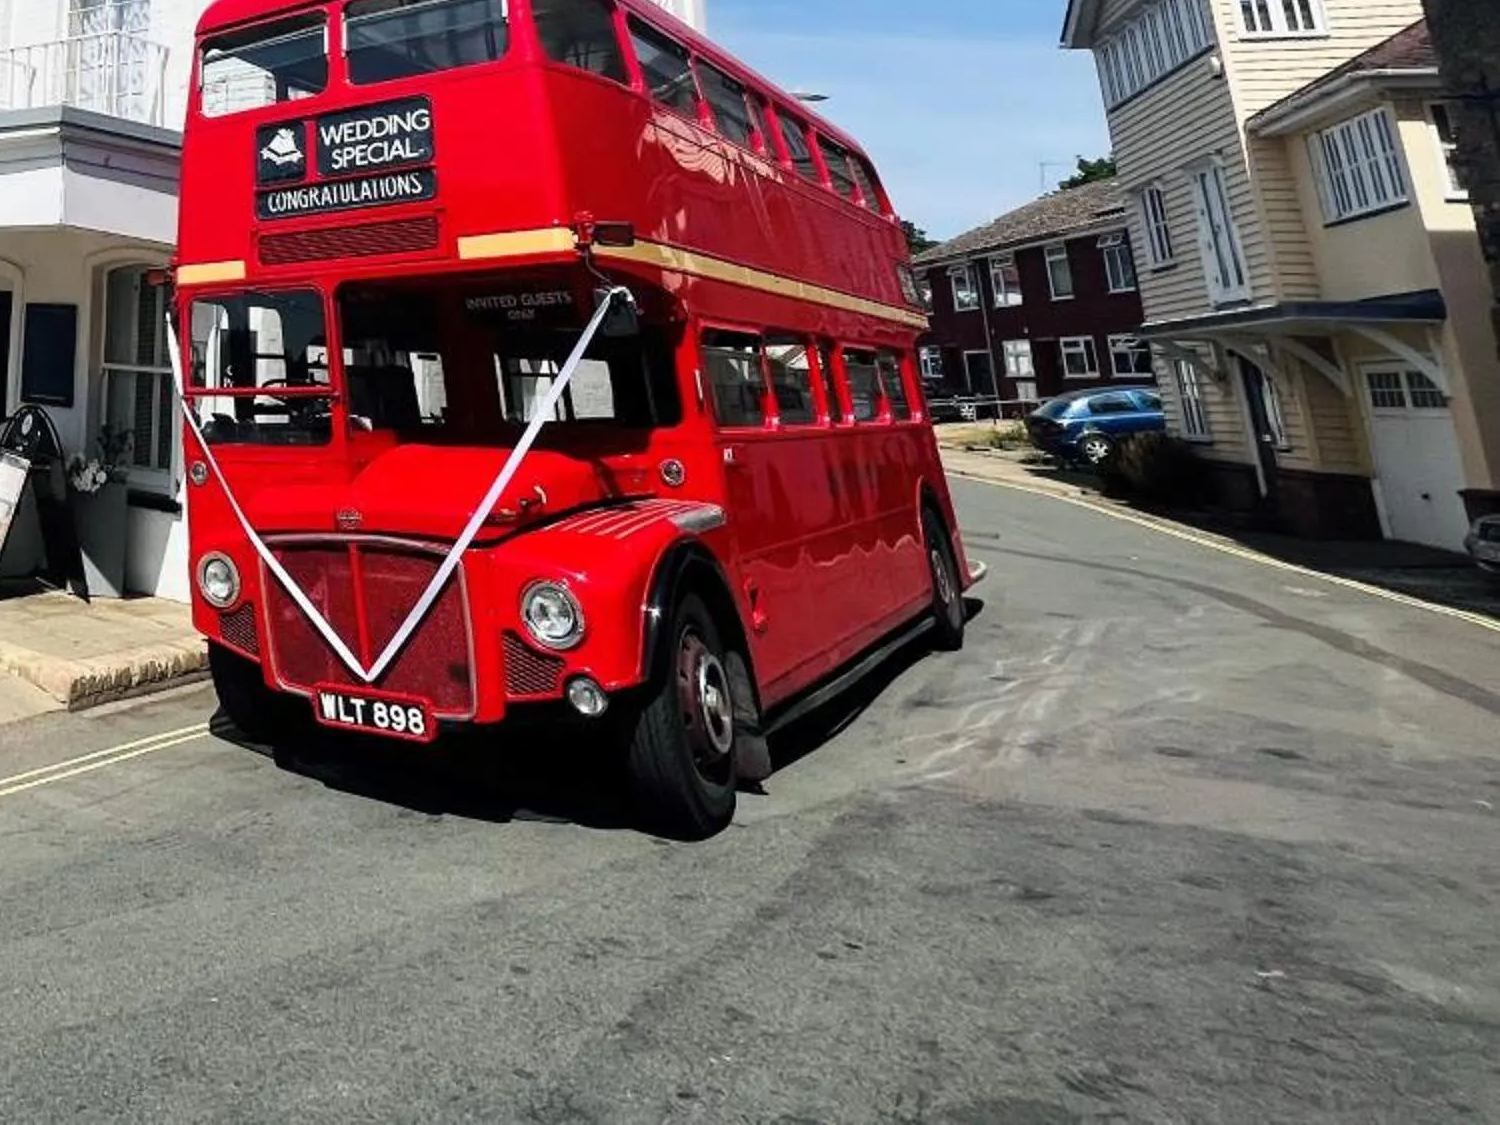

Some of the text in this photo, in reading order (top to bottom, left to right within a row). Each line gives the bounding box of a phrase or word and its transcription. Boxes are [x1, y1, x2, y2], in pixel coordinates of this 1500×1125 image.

[320, 108, 431, 146] WEDDING
[331, 137, 420, 170] SPECIAL
[267, 172, 423, 212] CONGRATULATIONS
[465, 291, 572, 310] INVITED GUESTS
[321, 692, 425, 735] WLT 898
